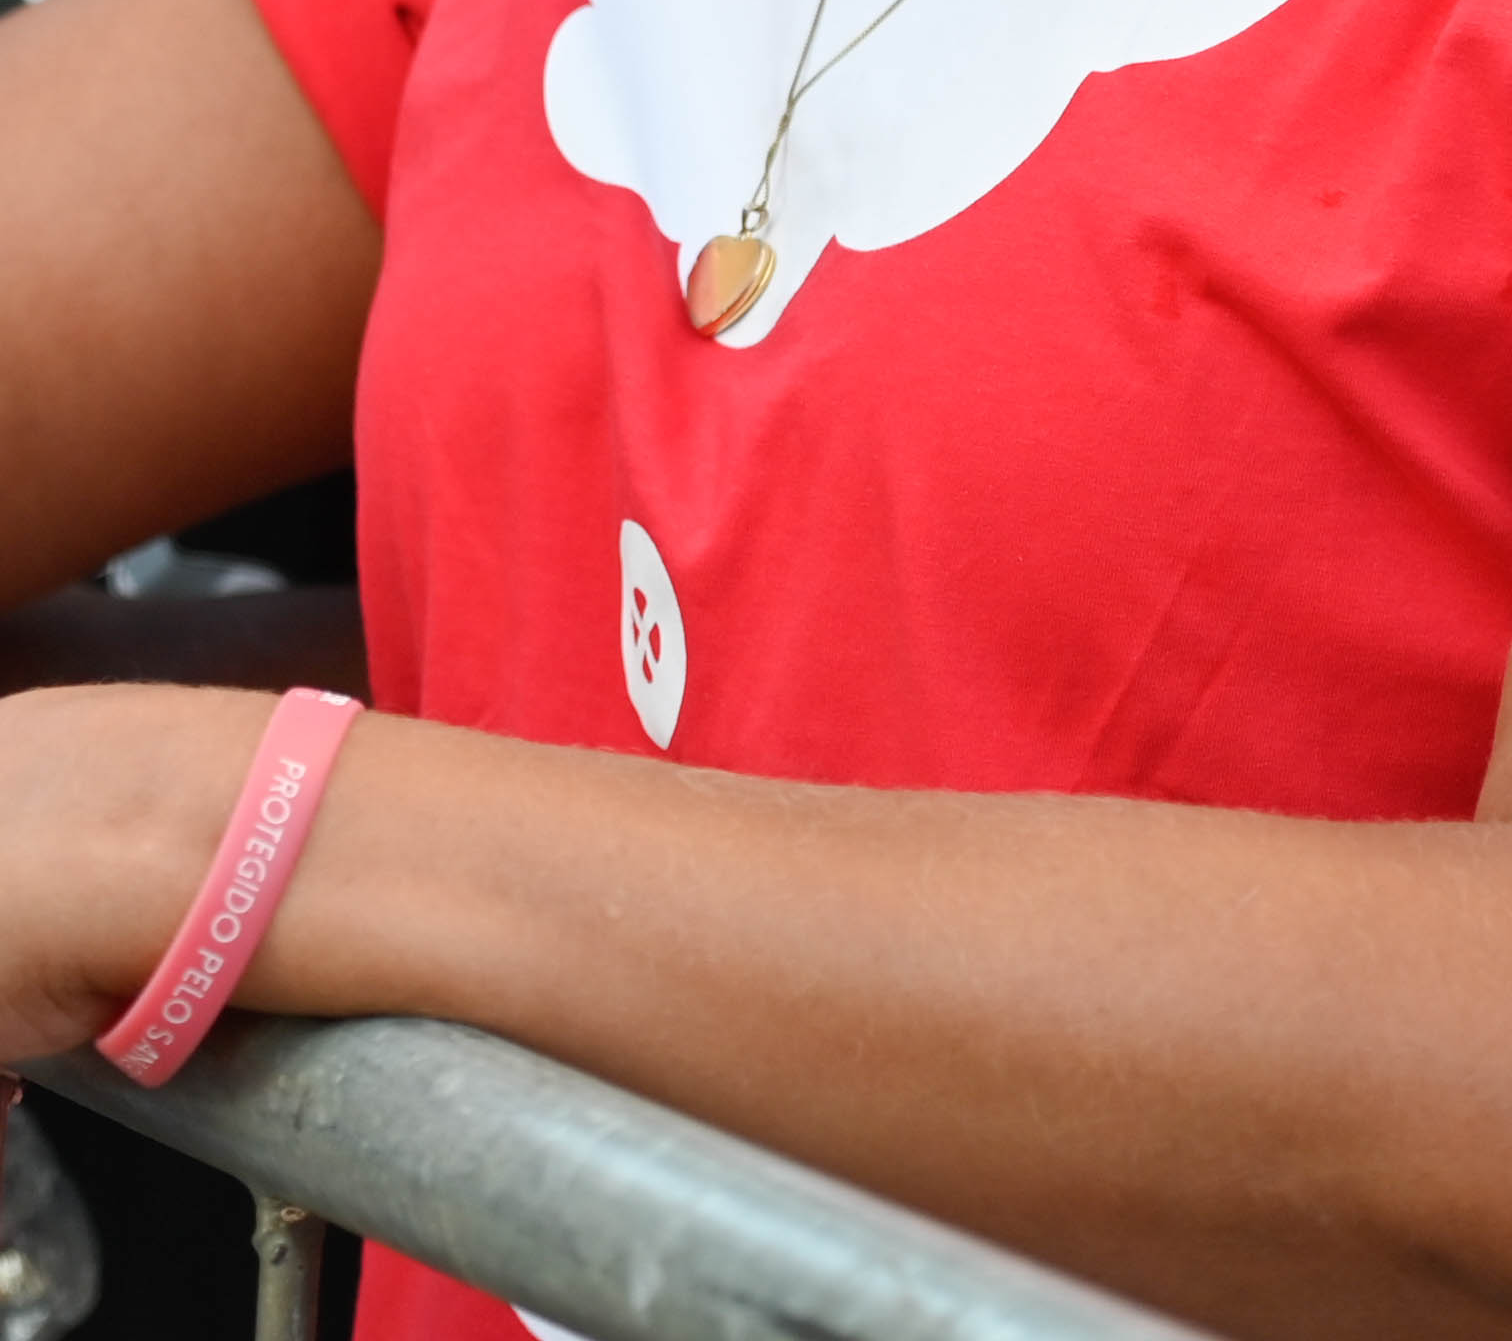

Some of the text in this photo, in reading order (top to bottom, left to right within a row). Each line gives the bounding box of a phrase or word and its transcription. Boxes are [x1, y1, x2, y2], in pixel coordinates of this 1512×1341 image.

[119, 757, 307, 1076] PROTEGIDO PELO SAN
